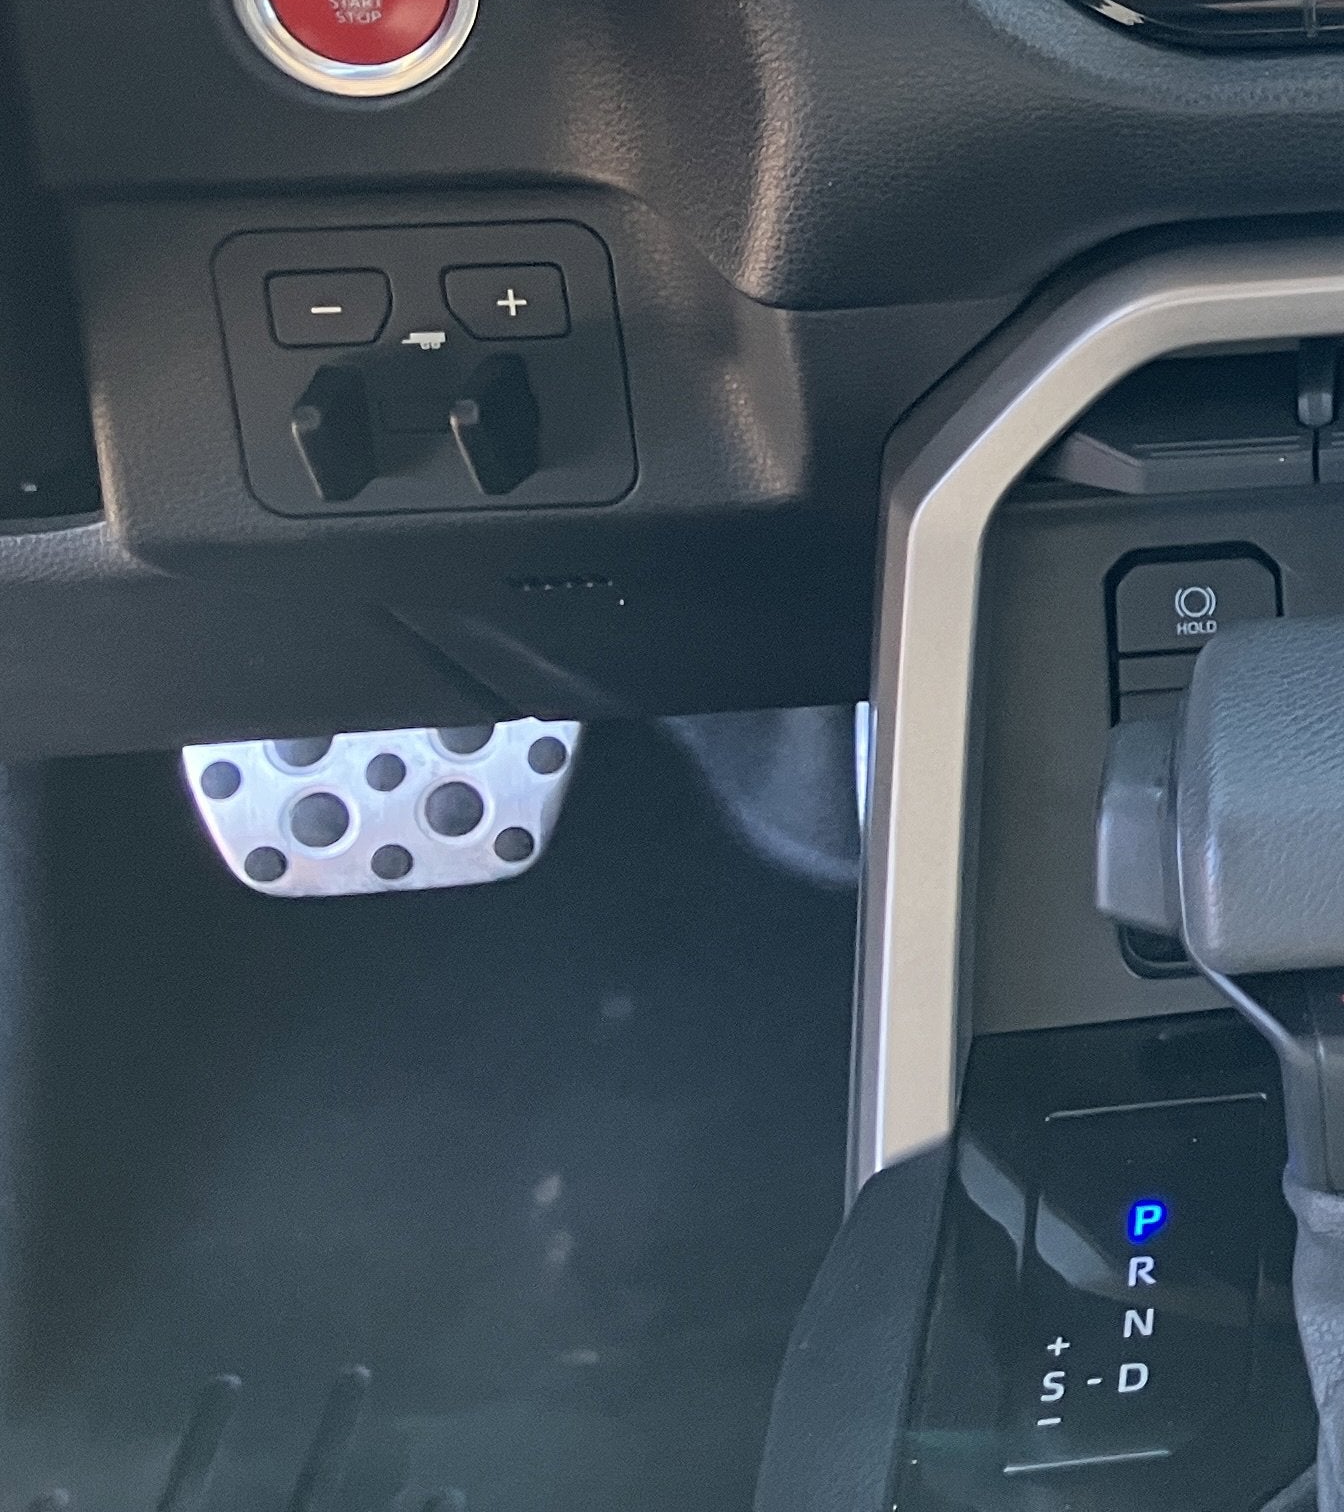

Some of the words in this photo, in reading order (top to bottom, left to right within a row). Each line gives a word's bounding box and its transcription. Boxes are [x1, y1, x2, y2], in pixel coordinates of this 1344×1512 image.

[335, 10, 382, 24] STOP
[1176, 619, 1218, 635] HOLD
[1132, 1202, 1164, 1238] P
[1128, 1256, 1157, 1286] R
[1123, 1308, 1155, 1337] N
[1040, 1371, 1066, 1402] S
[1118, 1363, 1149, 1392] D
